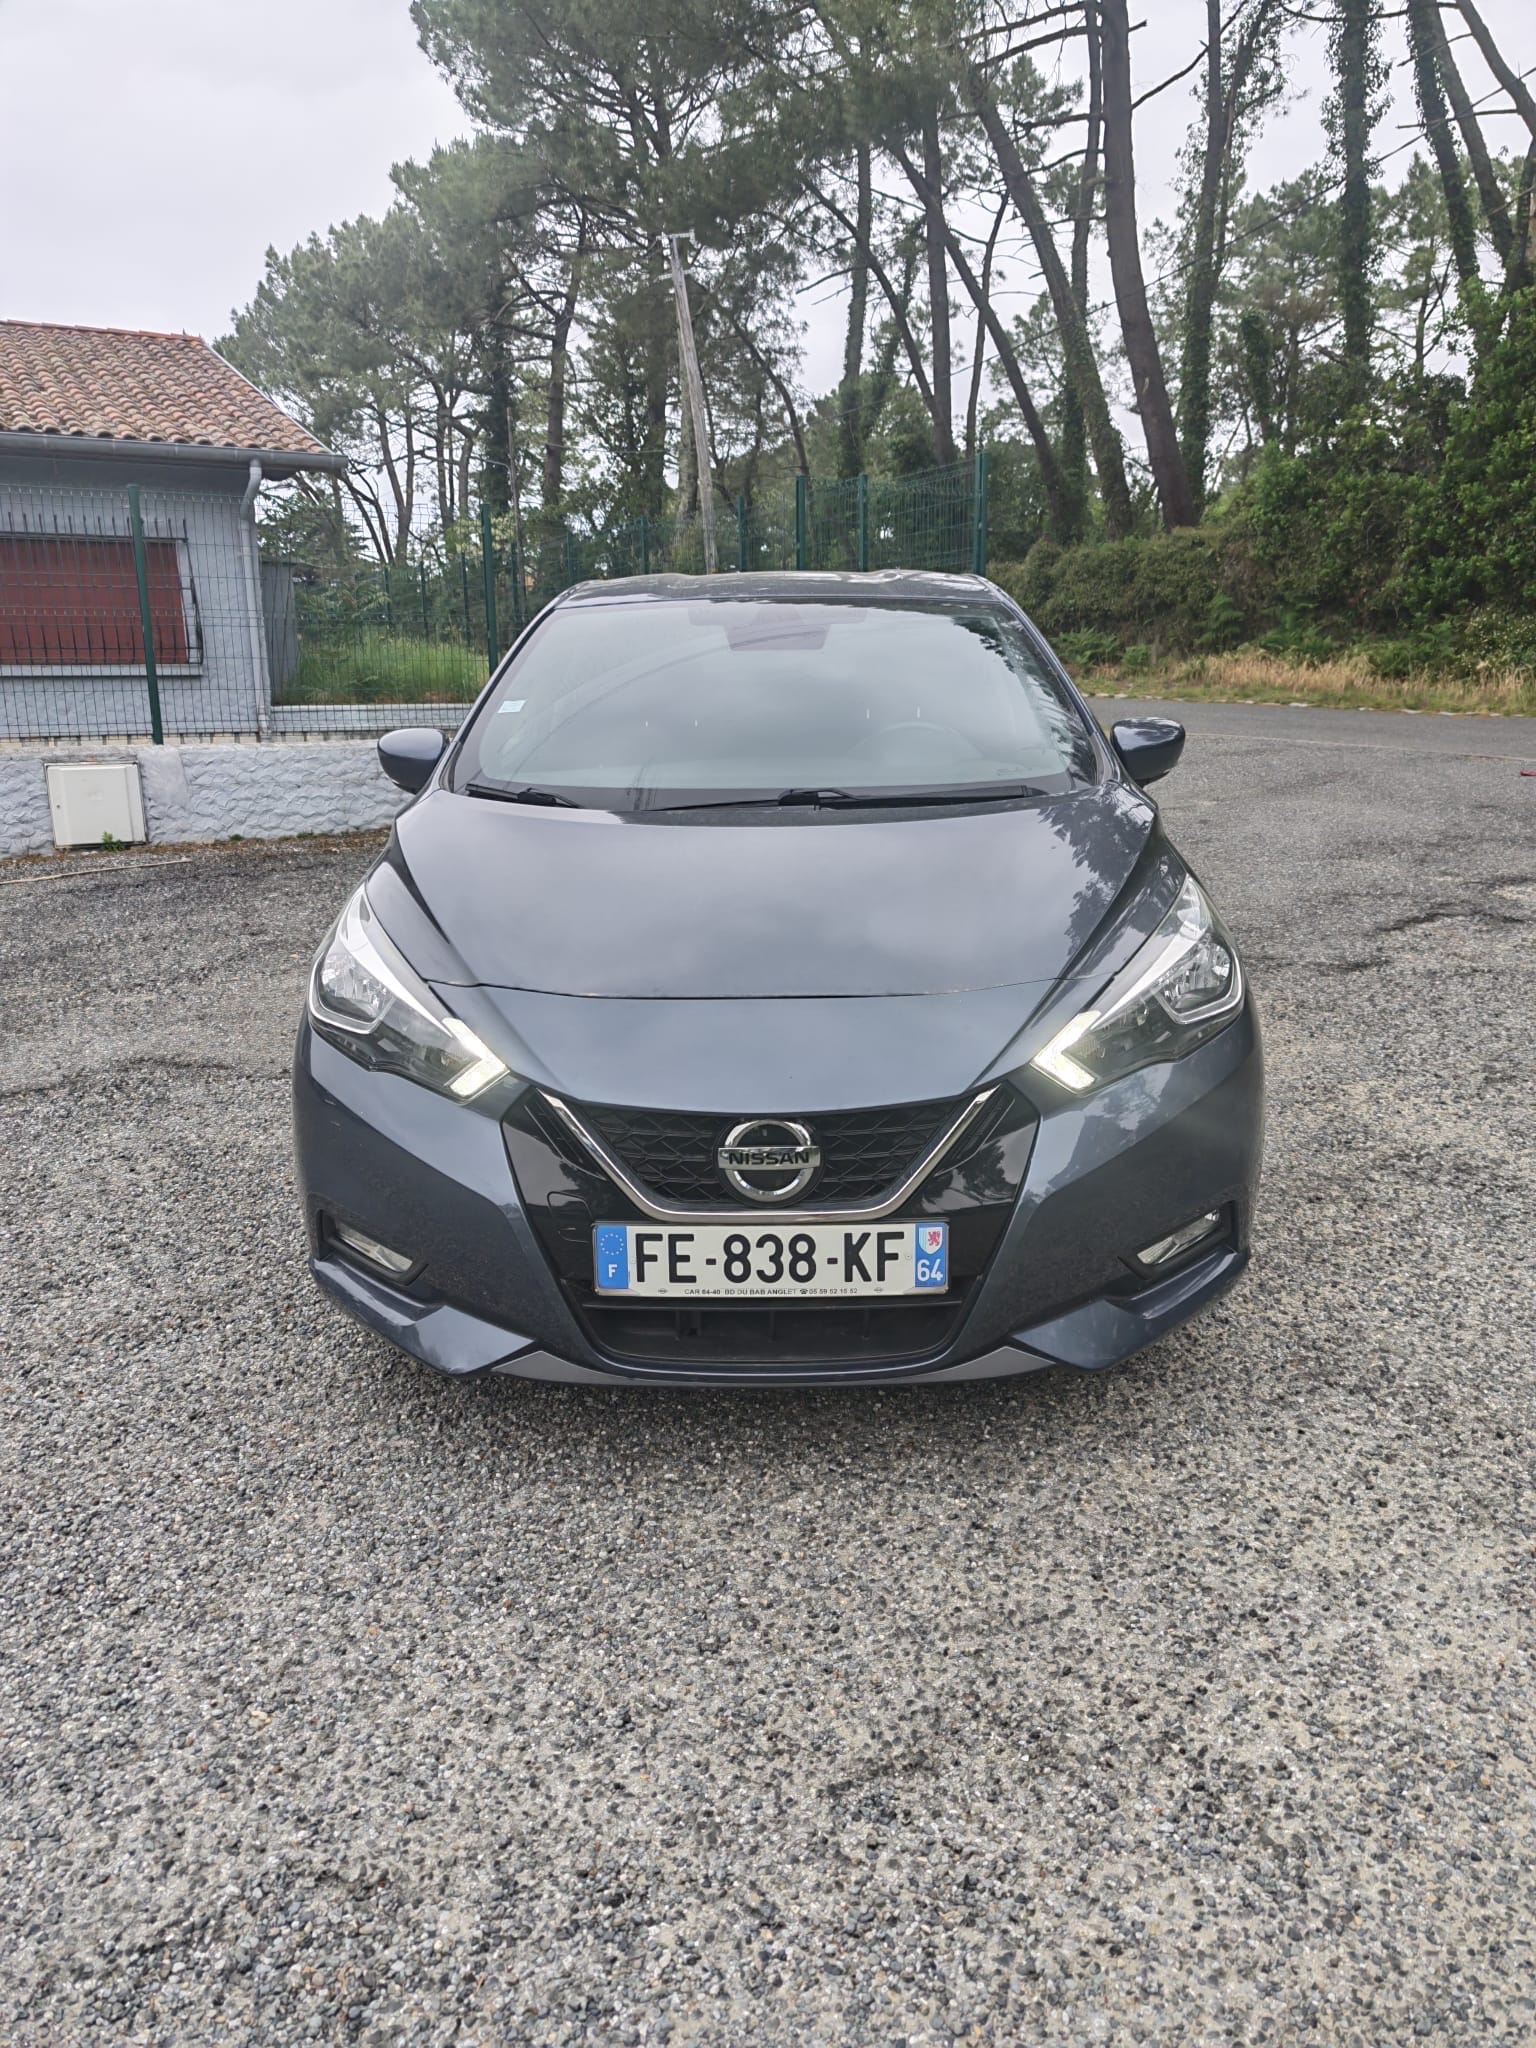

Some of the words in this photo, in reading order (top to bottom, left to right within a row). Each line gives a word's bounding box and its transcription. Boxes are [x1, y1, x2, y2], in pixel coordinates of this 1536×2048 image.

[729, 1151, 810, 1165] NISSAN
[634, 1231, 905, 1284] FE-838-KF
[607, 1264, 618, 1279] F
[916, 1258, 943, 1282] 64
